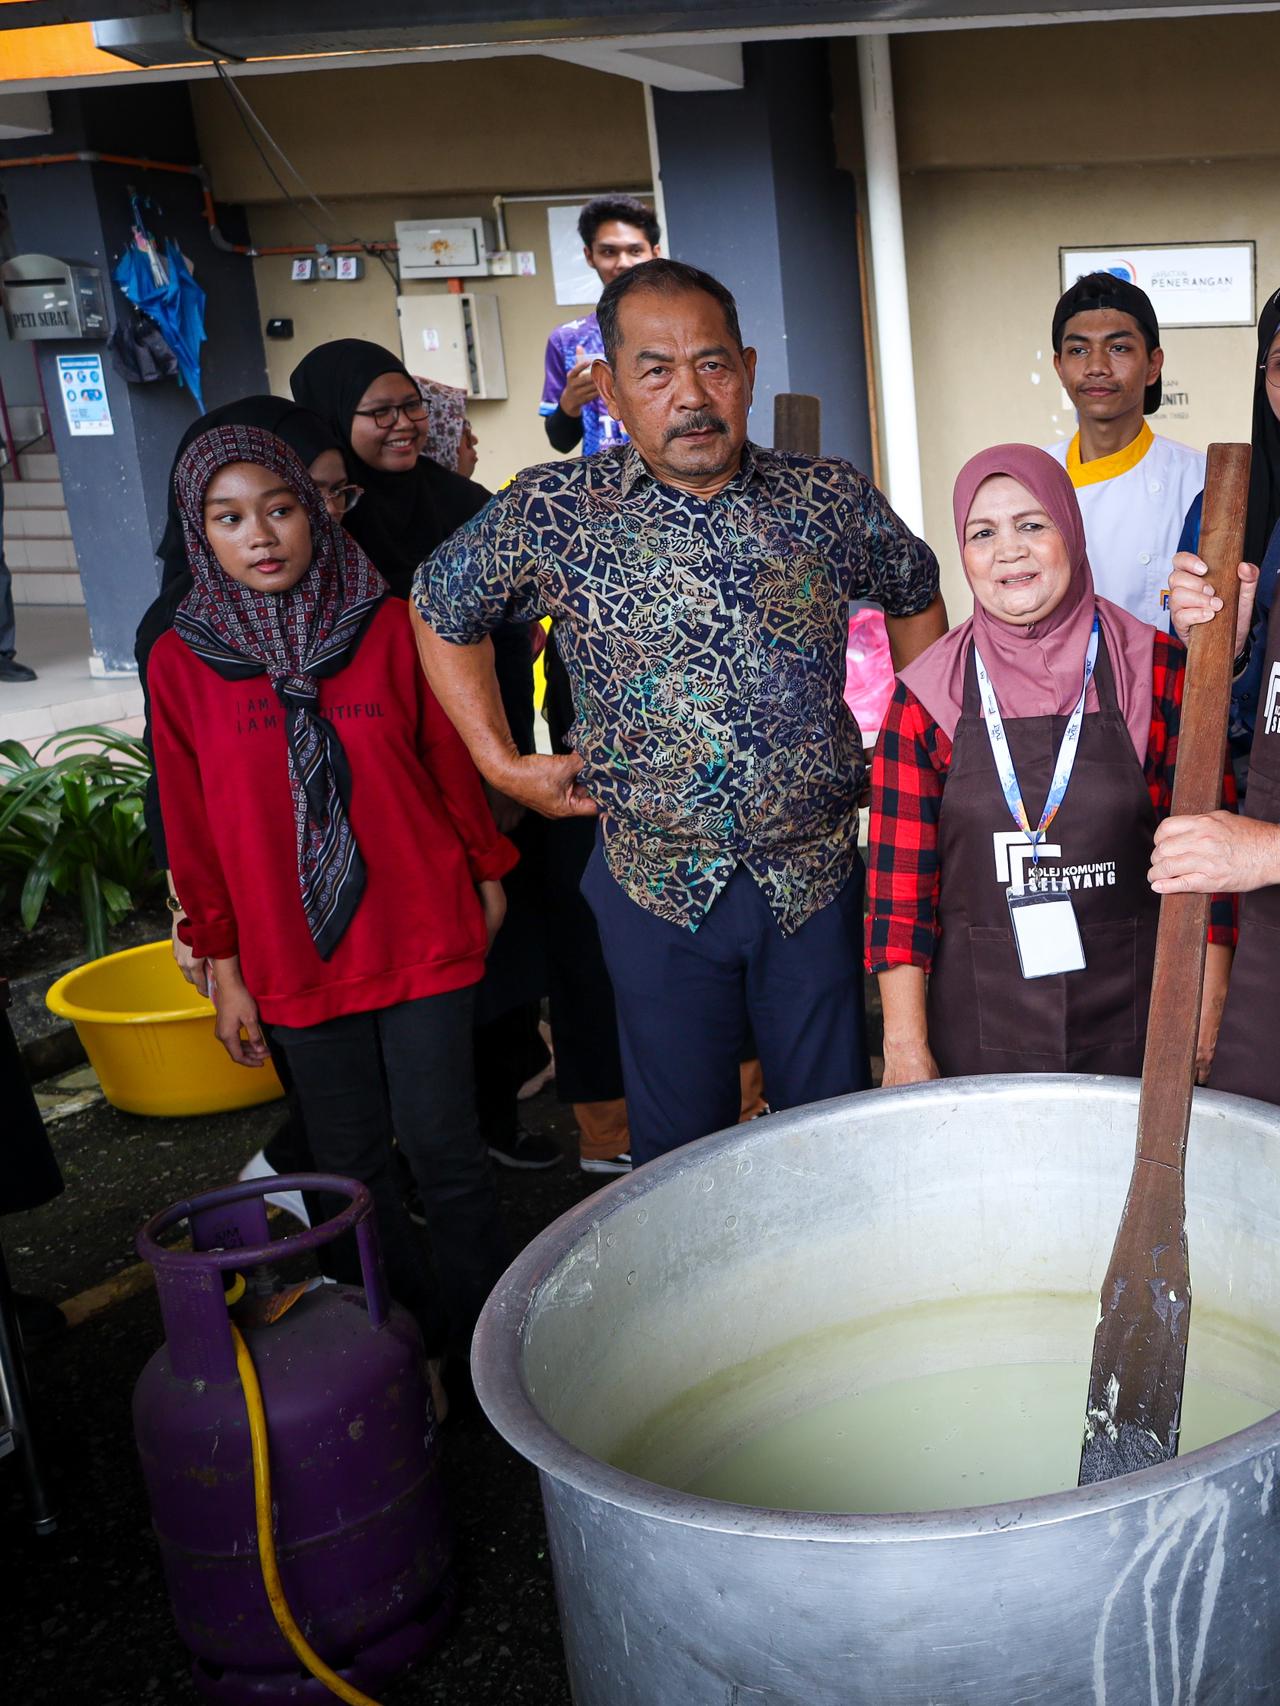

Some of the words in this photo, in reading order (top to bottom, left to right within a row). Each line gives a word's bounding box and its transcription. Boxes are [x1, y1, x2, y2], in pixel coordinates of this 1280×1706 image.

[1151, 277, 1233, 288] PENERANGAN
[13, 311, 36, 329] PETI
[38, 311, 69, 328] SURAT
[1028, 867, 1060, 877] KOLEJ
[1062, 861, 1116, 876] KOMUNITI
[1029, 871, 1116, 892] SELAYANG
